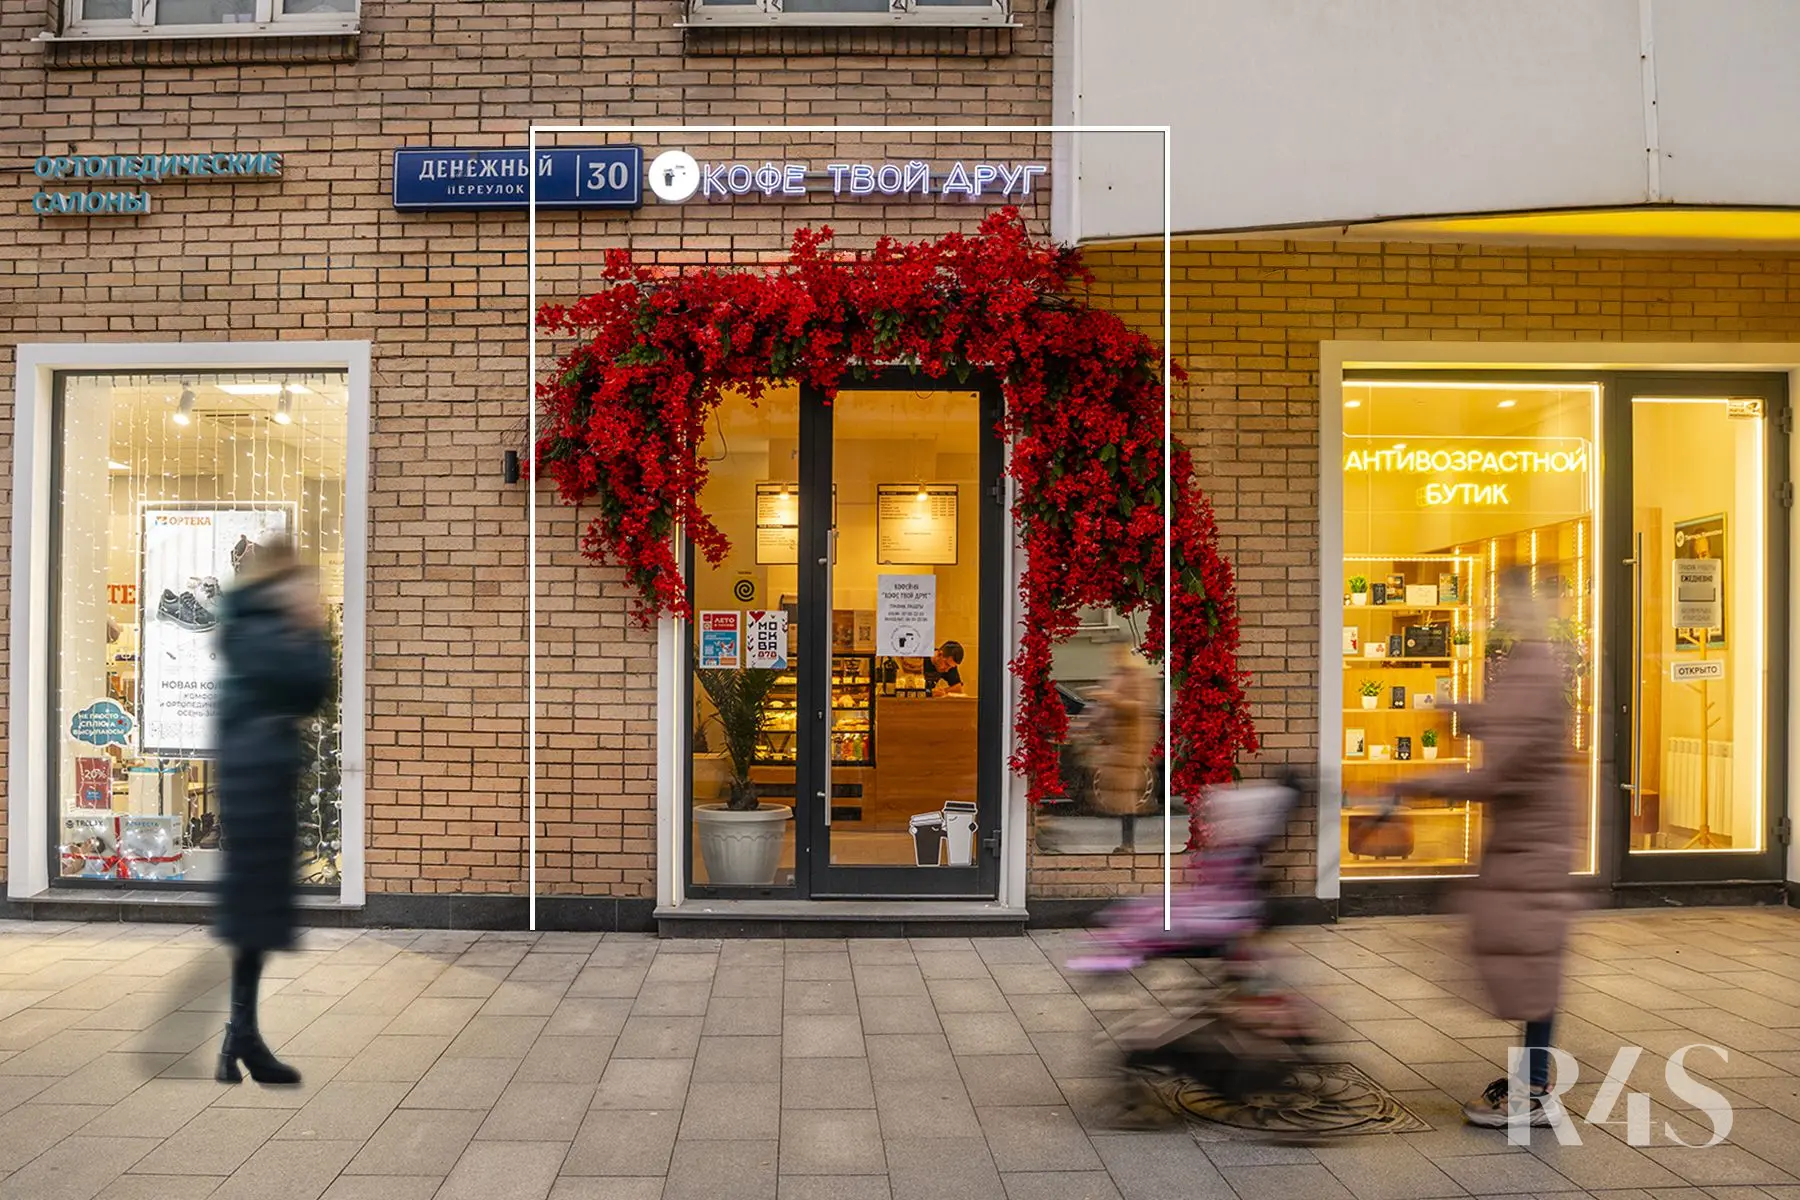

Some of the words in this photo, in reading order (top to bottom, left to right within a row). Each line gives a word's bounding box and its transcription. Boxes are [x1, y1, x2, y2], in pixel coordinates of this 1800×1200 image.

[34, 152, 281, 183] ОРТОПЕДИЧЕСКИЕ
[419, 155, 553, 180] ДЕНЕЖНЫЙ
[587, 161, 629, 190] 30
[703, 162, 807, 195] КОФЕ
[828, 160, 929, 194] ТВОЙ
[942, 161, 1047, 196] ДРУГ
[447, 184, 525, 195] ПЕРЕУЛОК
[32, 191, 151, 215] САЛОНЫ
[1343, 446, 1588, 473] АНТИВОЗРАСТНОЙ
[1425, 483, 1509, 505] БУТИК
[169, 516, 212, 526] ОРТЕКА
[1678, 666, 1718, 677] ОТКРЫТО
[161, 680, 198, 690] НОВАЯ
